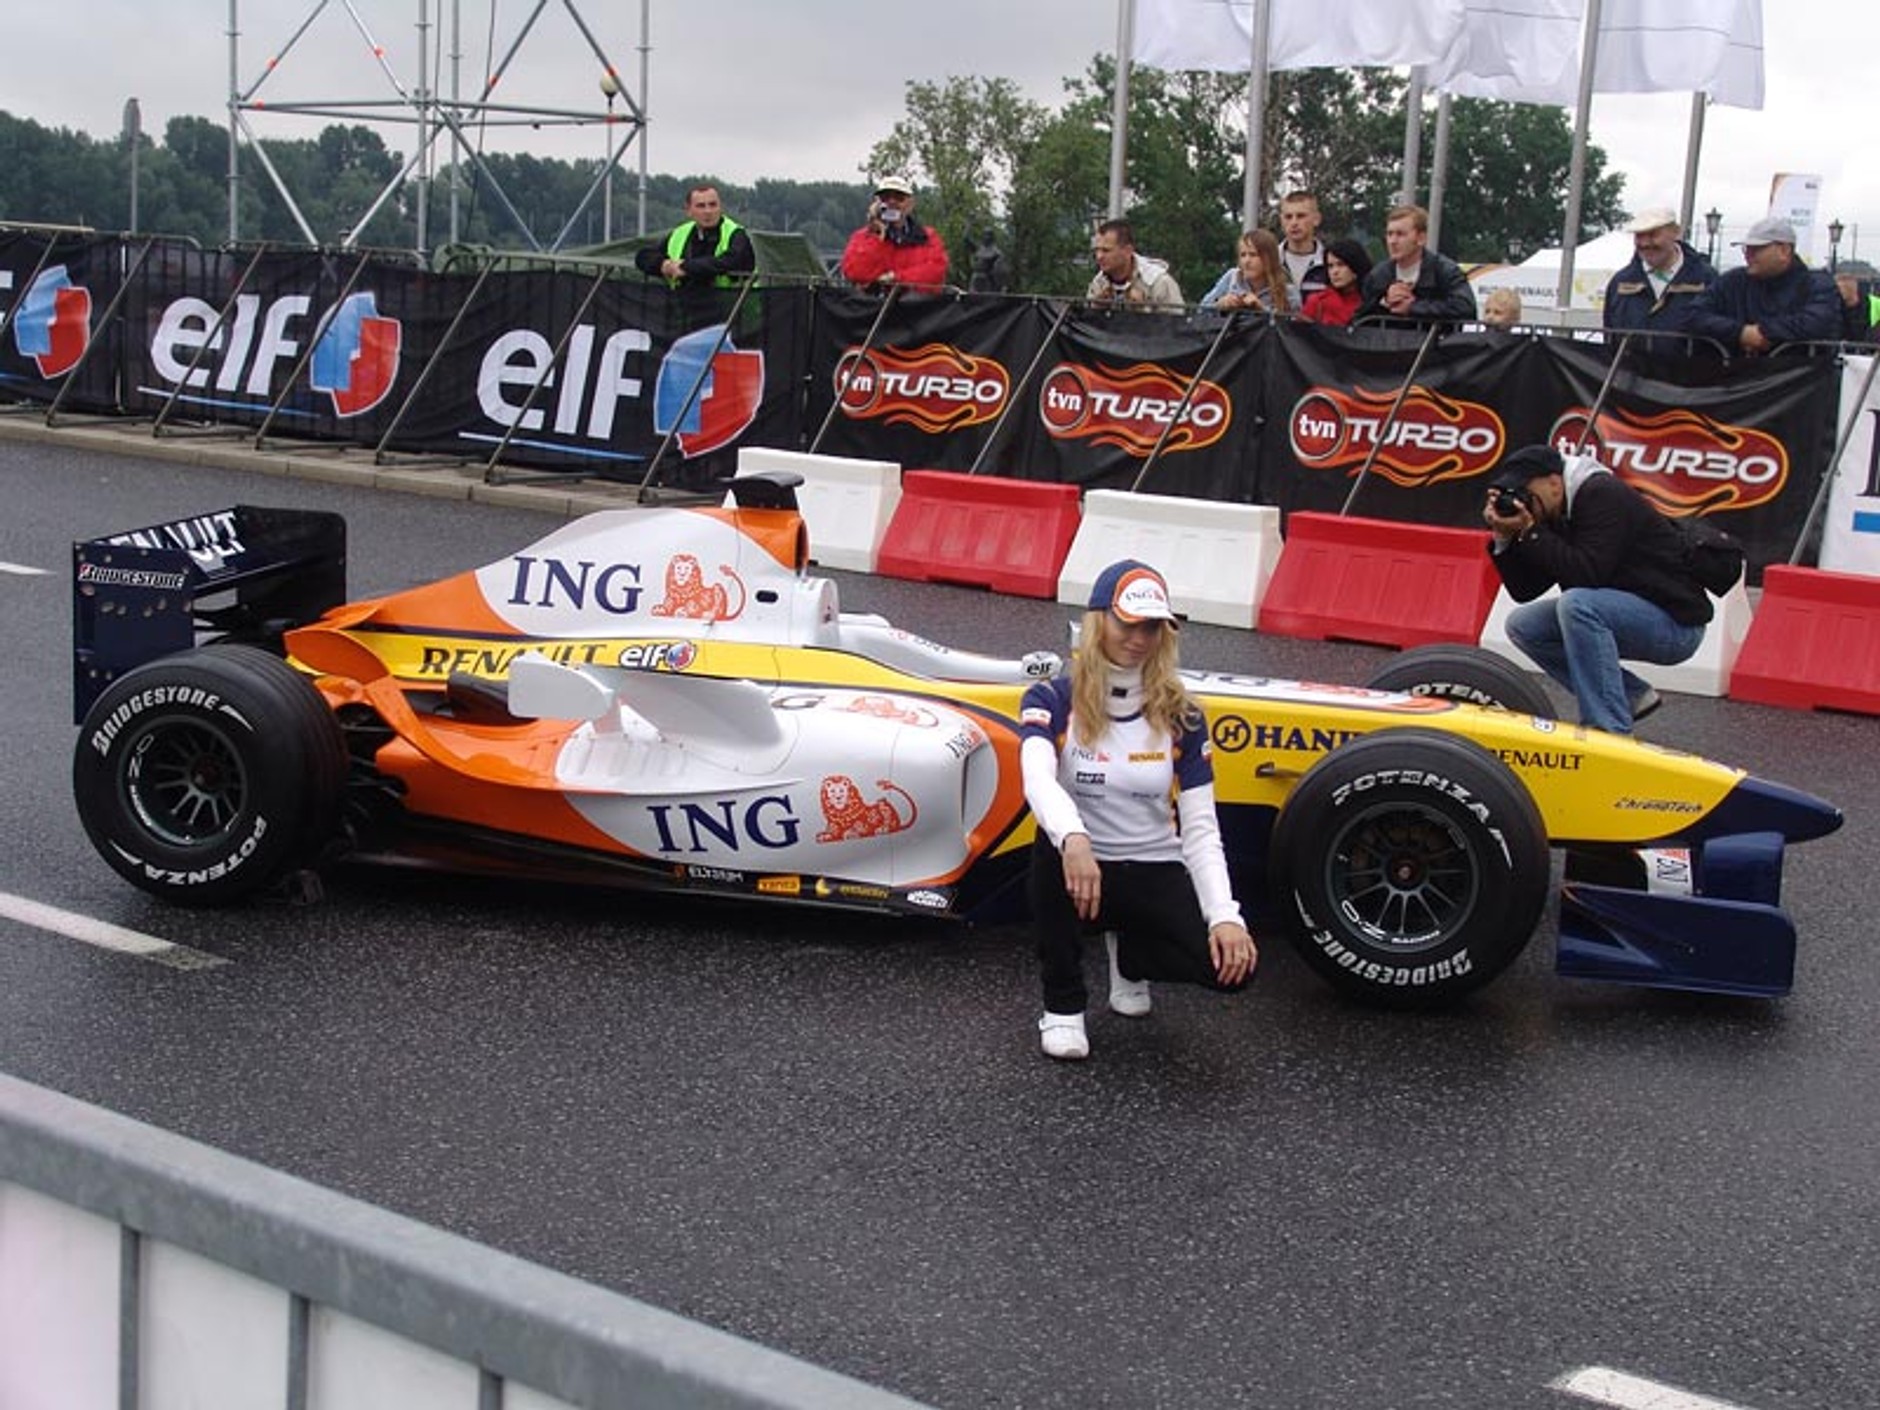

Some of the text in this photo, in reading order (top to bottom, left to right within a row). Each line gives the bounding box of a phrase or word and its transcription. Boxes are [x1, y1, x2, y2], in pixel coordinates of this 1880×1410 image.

[150, 294, 311, 396] elf
[476, 324, 652, 441] elf
[1048, 386, 1081, 411] tvn
[1299, 412, 1336, 440] tvn
[507, 556, 643, 615] ING
[620, 646, 667, 667] elf
[92, 686, 220, 757] BRIDGESTONE
[1492, 748, 1585, 770] ENAULT
[646, 795, 800, 852] ING
[1332, 770, 1490, 825] POTENZA
[1313, 929, 1474, 986] BRIDGESTONE
